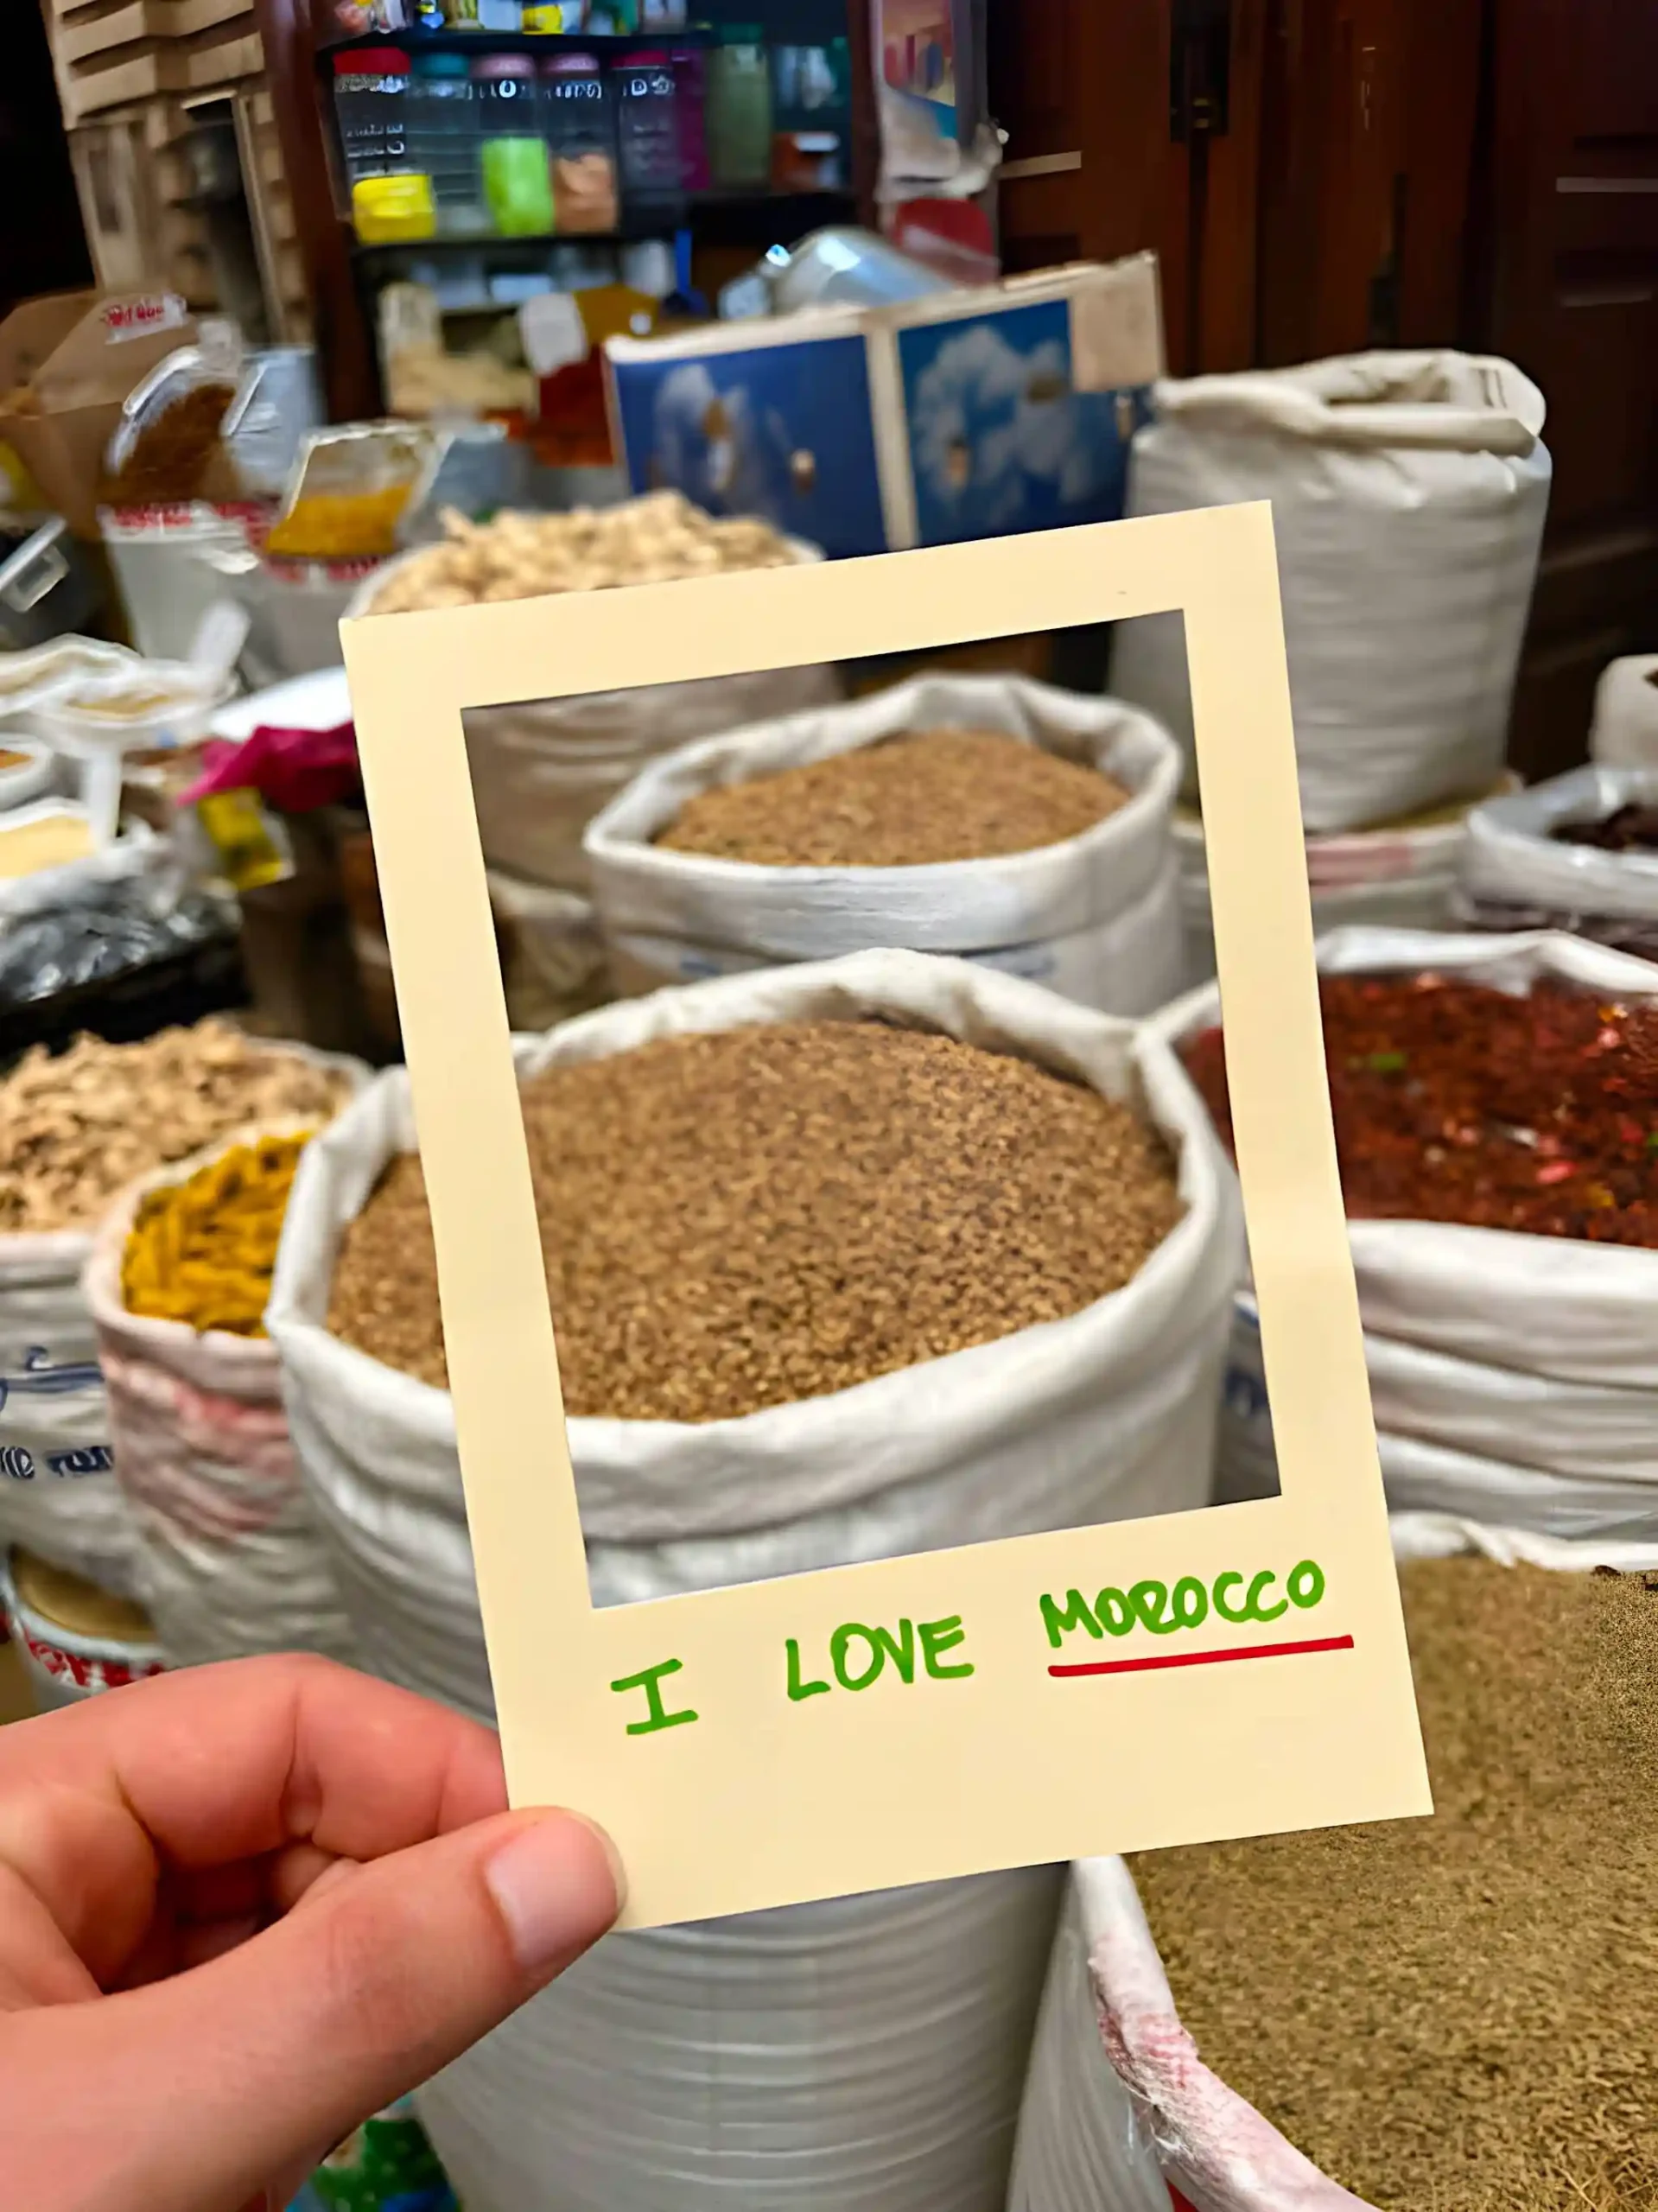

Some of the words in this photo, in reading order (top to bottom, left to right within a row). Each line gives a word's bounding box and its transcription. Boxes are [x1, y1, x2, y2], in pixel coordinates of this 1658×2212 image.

[610, 1657, 699, 1736] I
[785, 1616, 975, 1702] LOVE
[1039, 1559, 1325, 1649] MOROCCO
